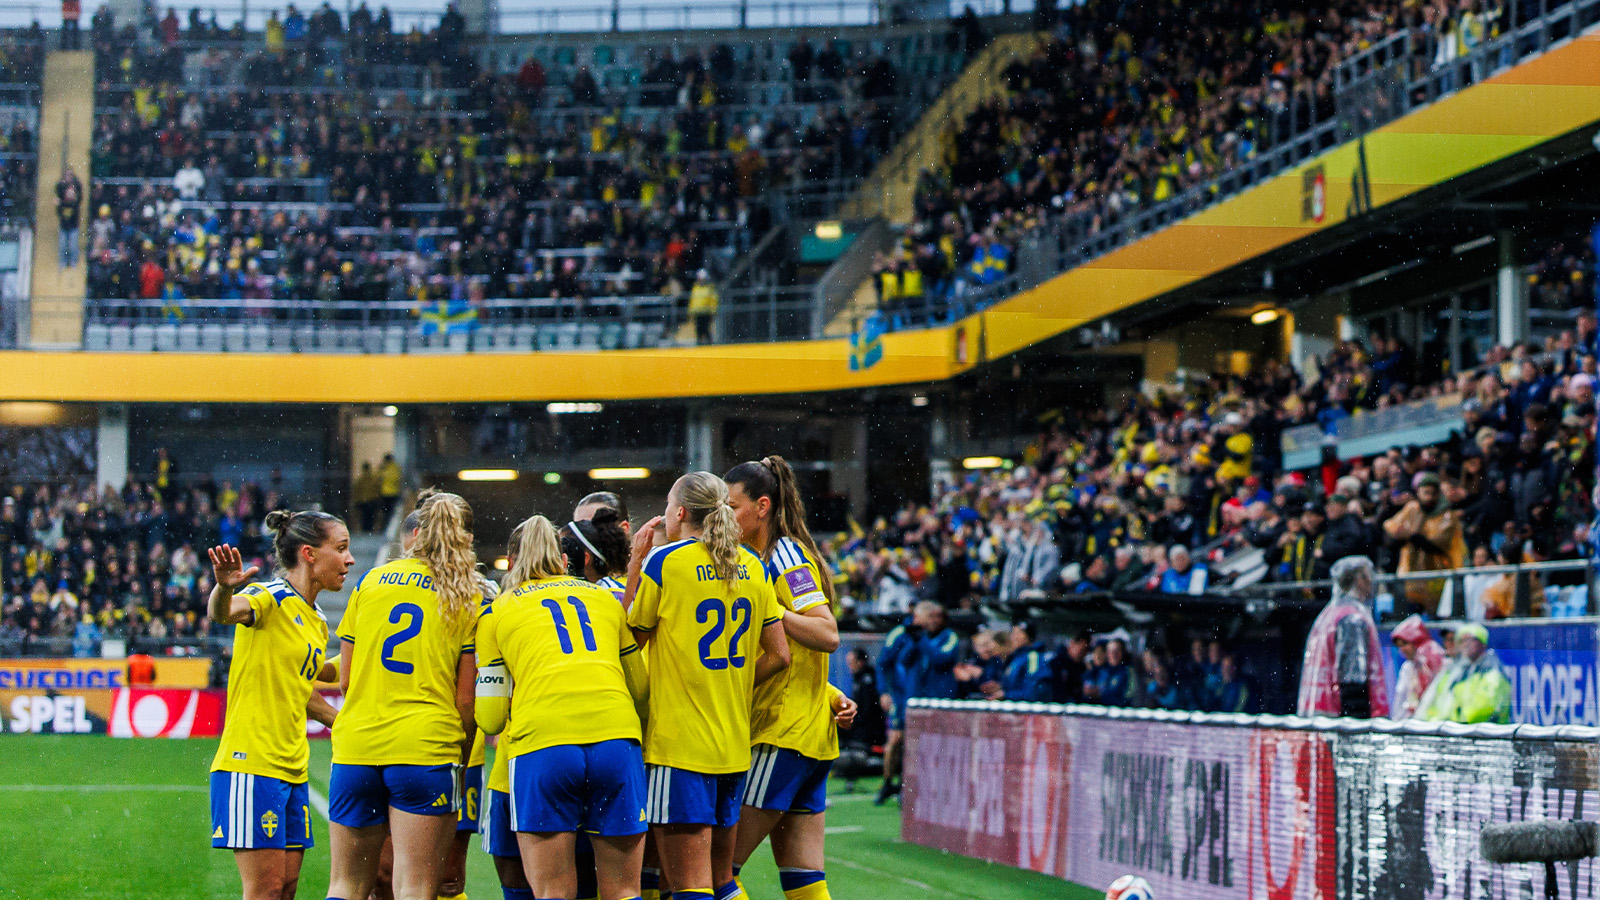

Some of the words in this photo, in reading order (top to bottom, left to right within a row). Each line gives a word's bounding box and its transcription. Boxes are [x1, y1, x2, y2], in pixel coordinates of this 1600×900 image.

[696, 564, 750, 581] NELGE
[381, 602, 424, 675] 2
[541, 595, 598, 655] 11
[695, 597, 752, 670] 22
[300, 642, 323, 681] 15
[480, 676, 504, 684] LOVE
[10, 695, 93, 733] SPEL
